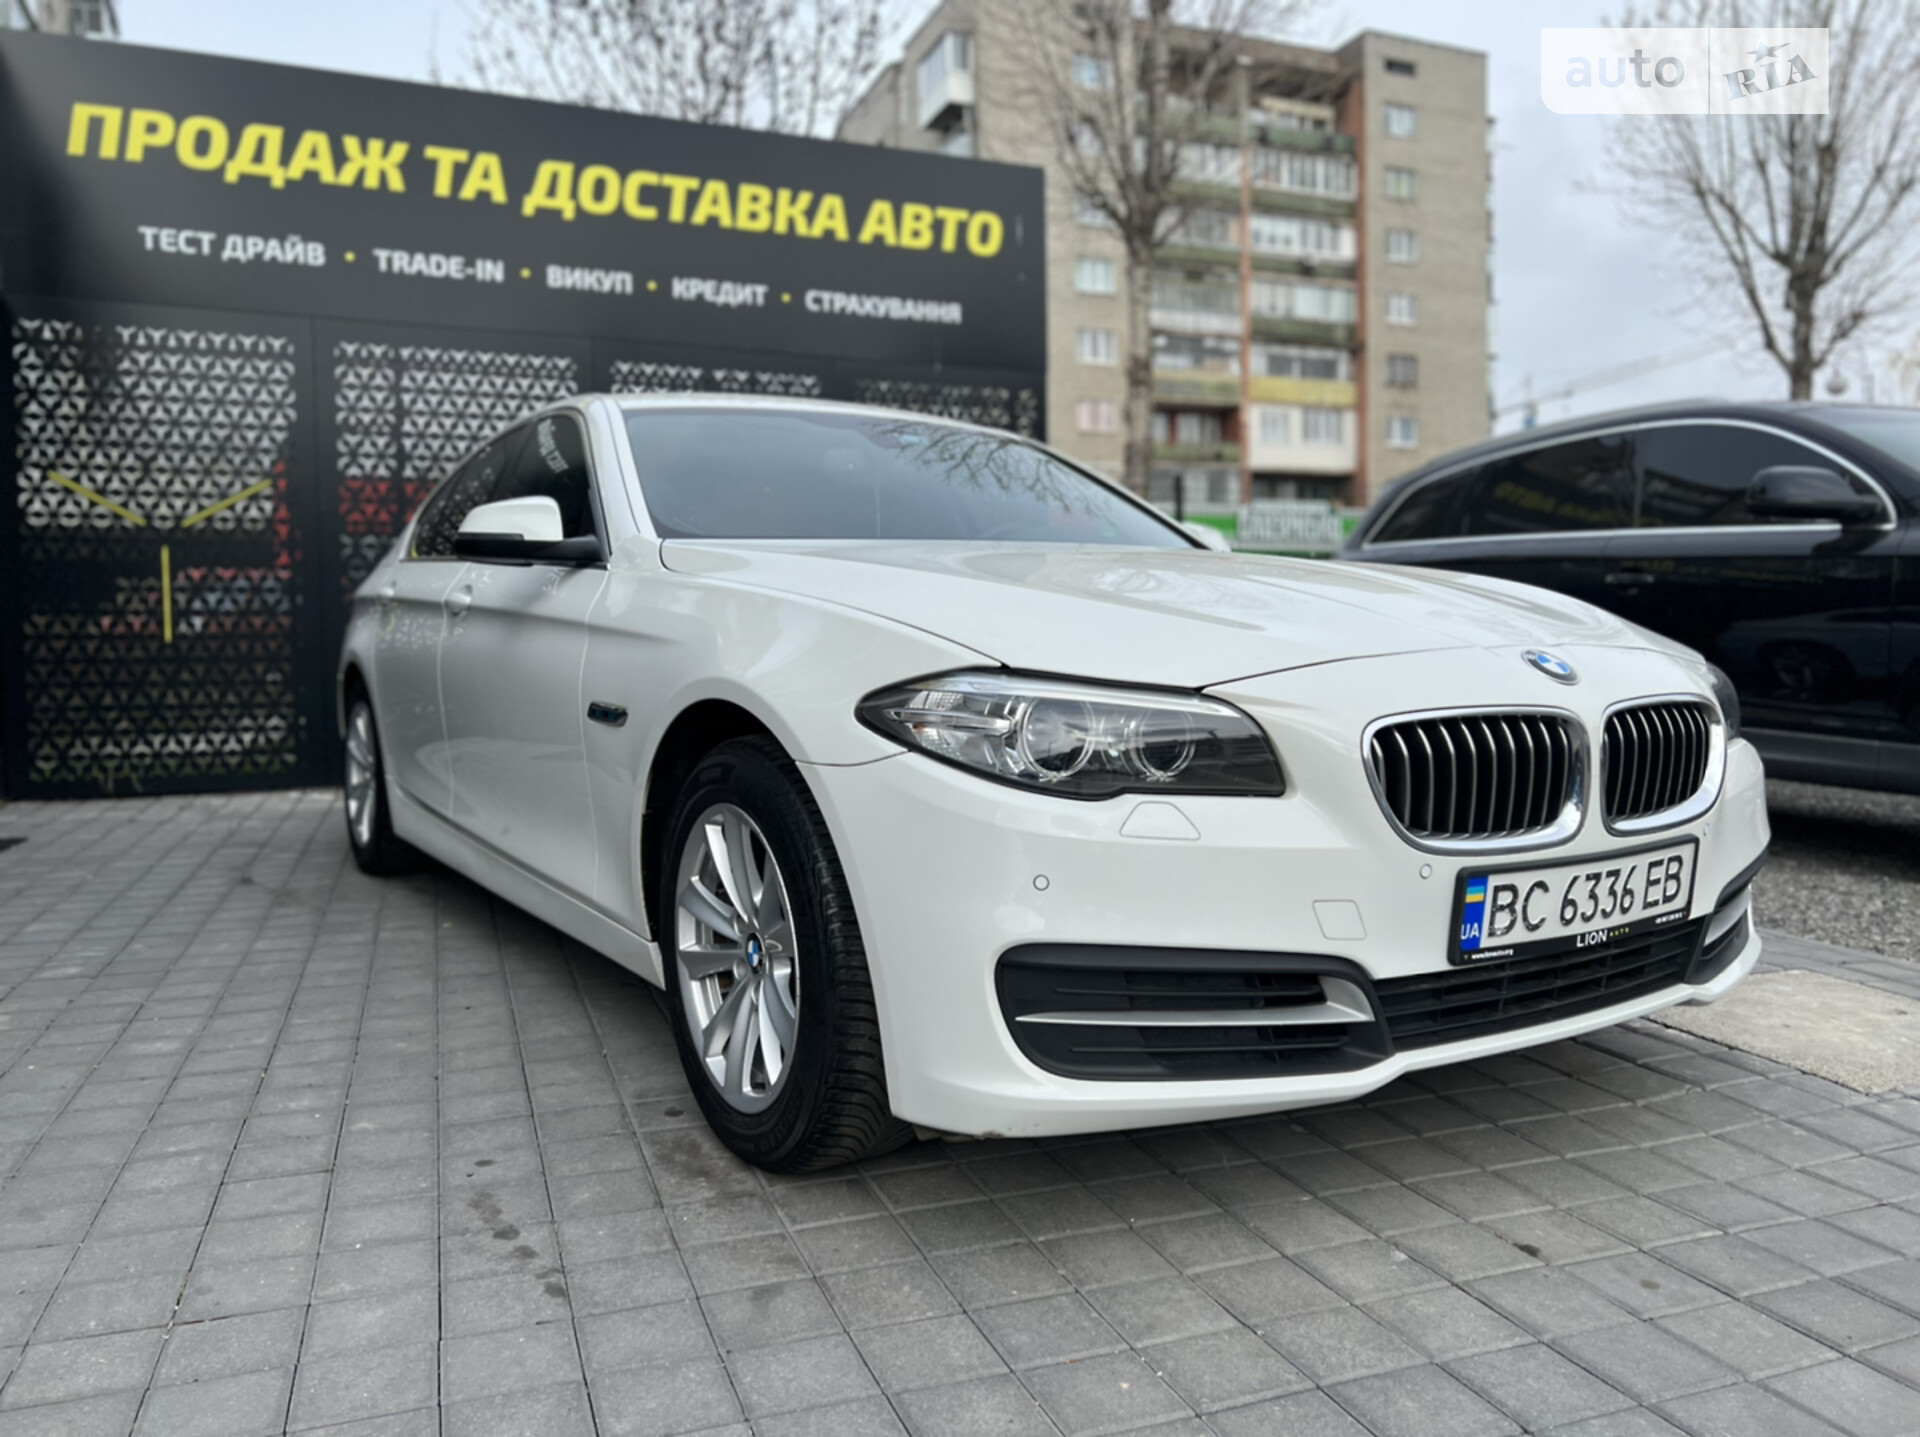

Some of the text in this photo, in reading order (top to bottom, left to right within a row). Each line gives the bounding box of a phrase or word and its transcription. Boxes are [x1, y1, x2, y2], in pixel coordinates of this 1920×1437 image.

[66, 102, 1004, 258] ПРОДАЖ ТА ДОСТАВКА АВТО
[138, 225, 963, 325] ТЕСТ ДРАЙВ TRADE-IN ВИКУП КРЕДИТ СТРАХУВАННЯ
[1560, 865, 1638, 926] 6336
[1460, 923, 1480, 940] UA
[1576, 929, 1608, 948] LION
